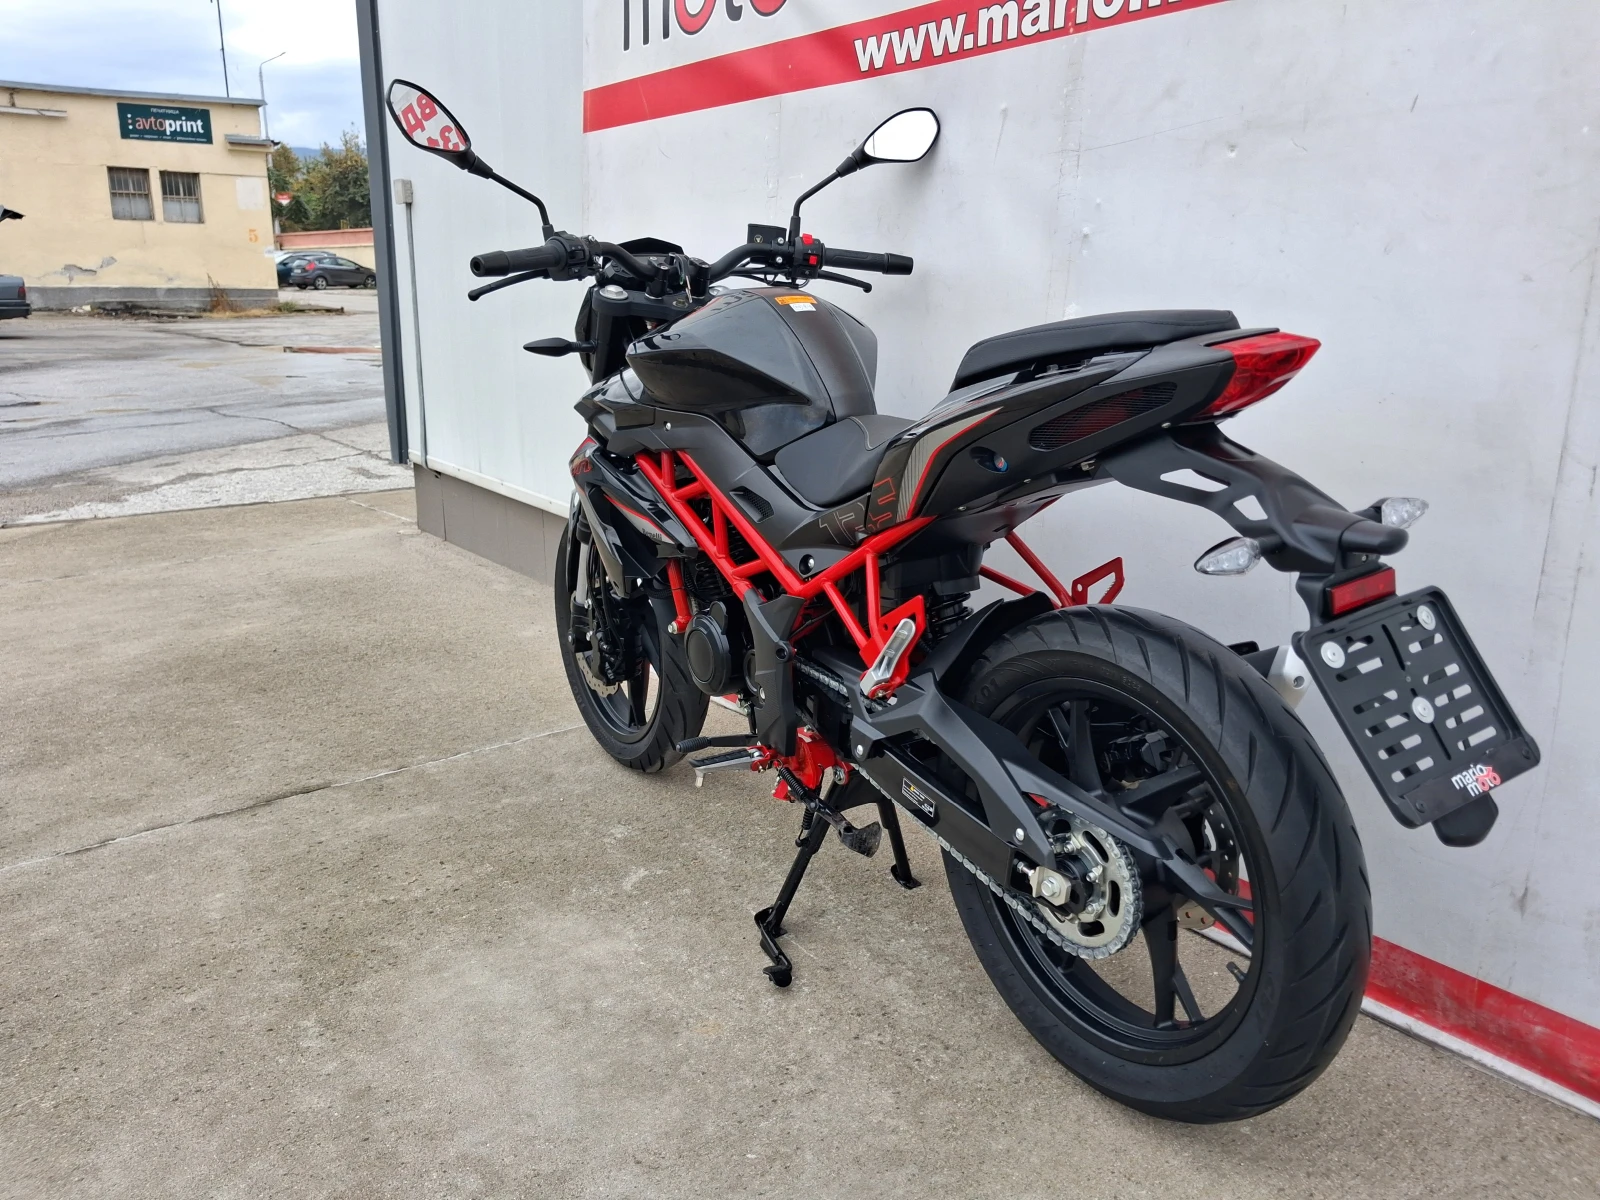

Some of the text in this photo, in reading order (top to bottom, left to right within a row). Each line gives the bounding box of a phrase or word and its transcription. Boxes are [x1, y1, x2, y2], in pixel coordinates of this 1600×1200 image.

[135, 116, 204, 136] avtoprint
[248, 228, 259, 243] 5
[1451, 764, 1486, 790] mario
[1466, 772, 1501, 797] moto
